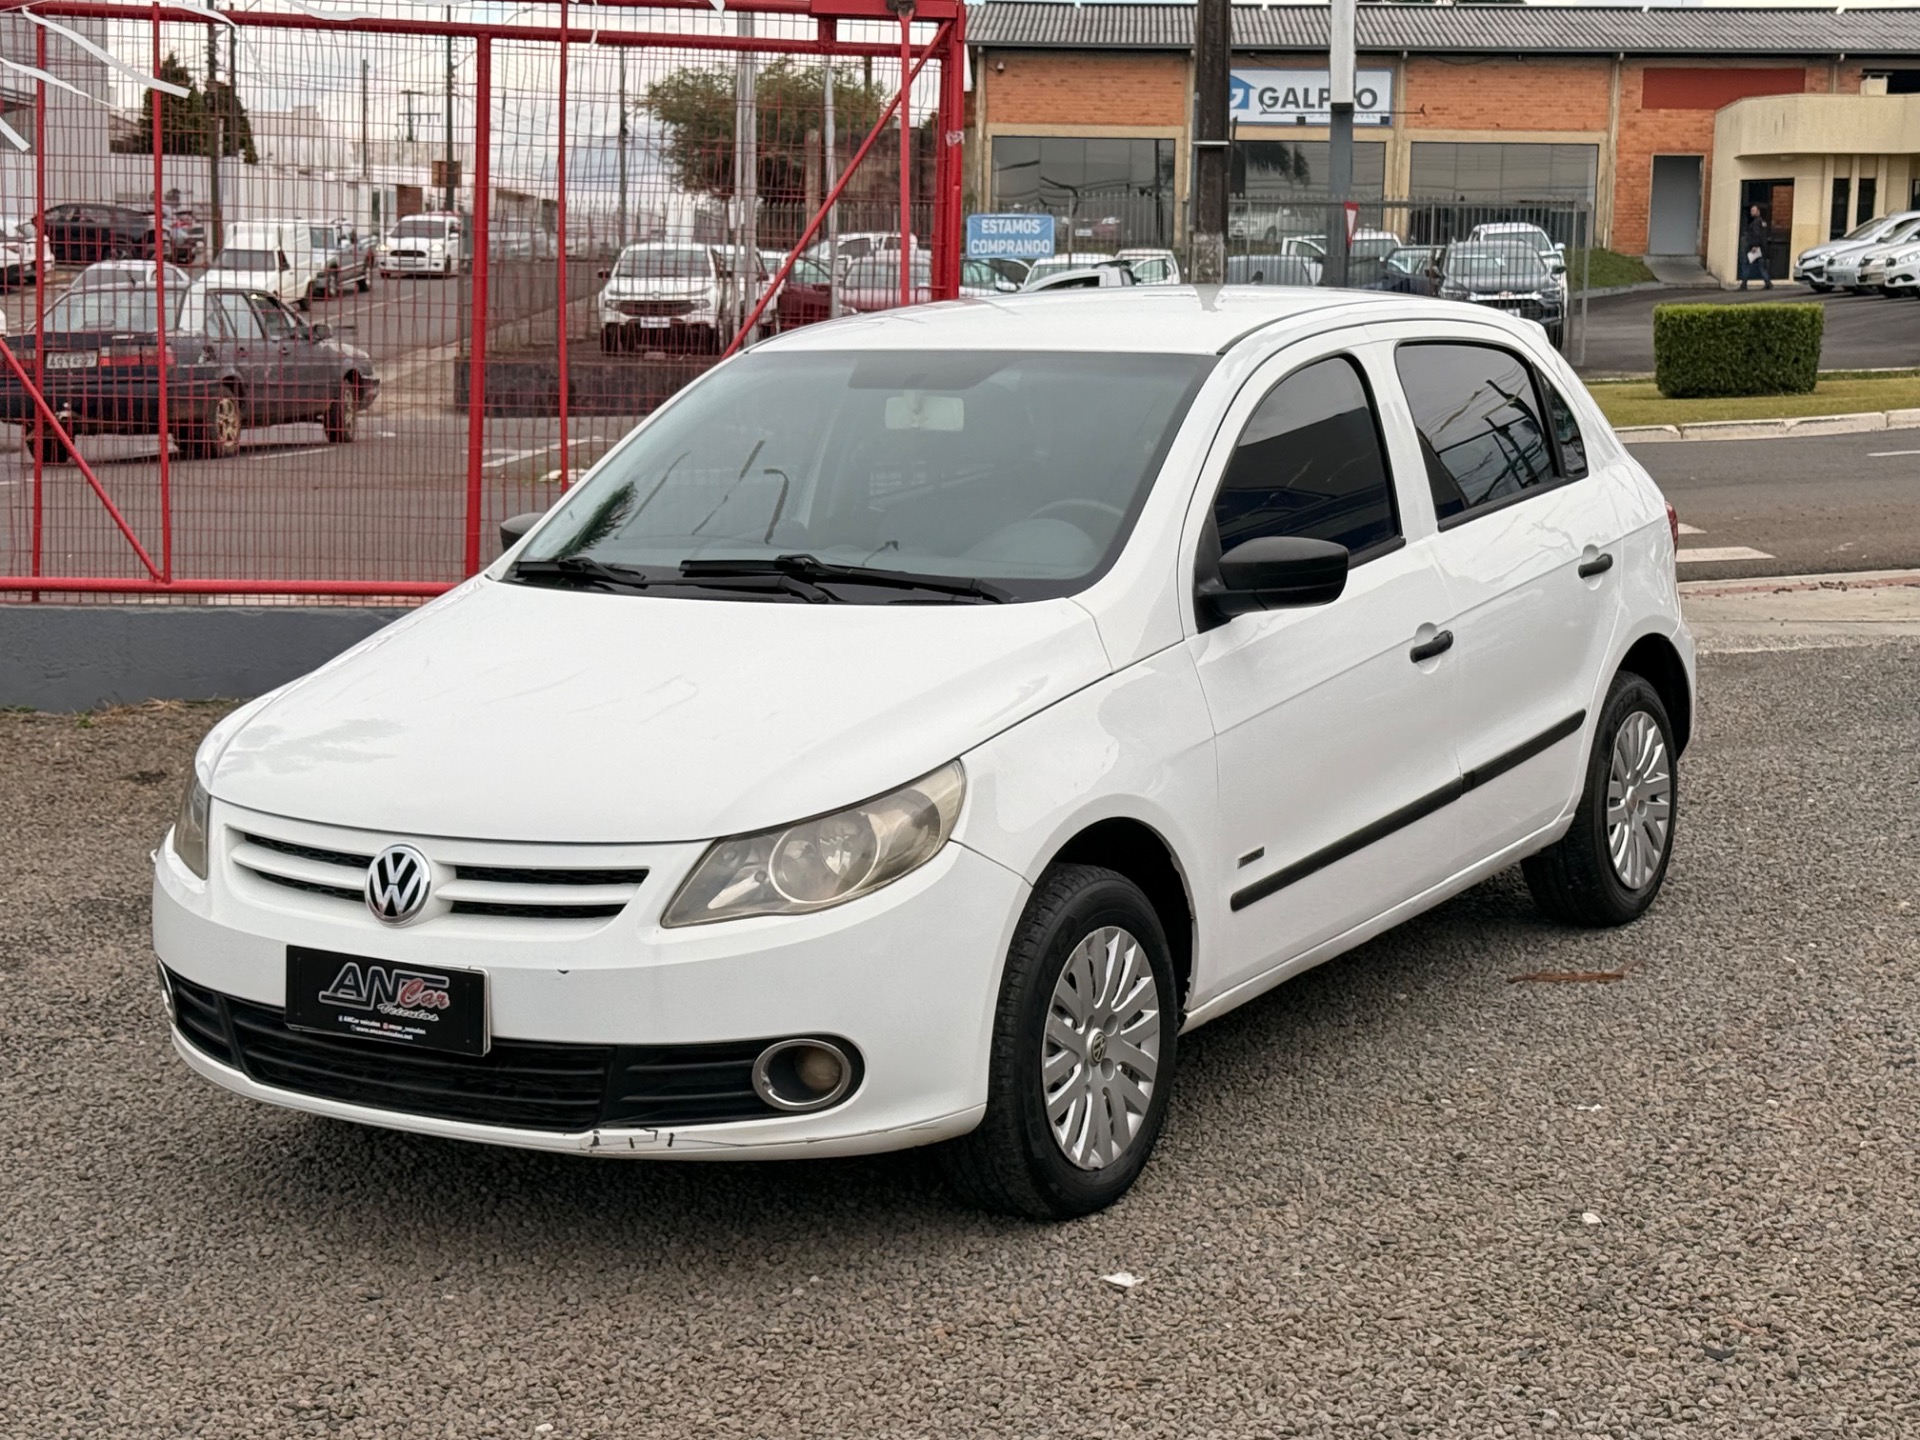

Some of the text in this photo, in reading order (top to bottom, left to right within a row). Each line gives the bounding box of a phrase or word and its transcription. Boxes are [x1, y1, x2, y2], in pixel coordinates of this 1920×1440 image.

[1258, 86, 1378, 109] GALPO
[981, 219, 1041, 234] ESTAMOS
[971, 239, 1050, 254] COMPRANDO
[400, 978, 450, 1009] Car
